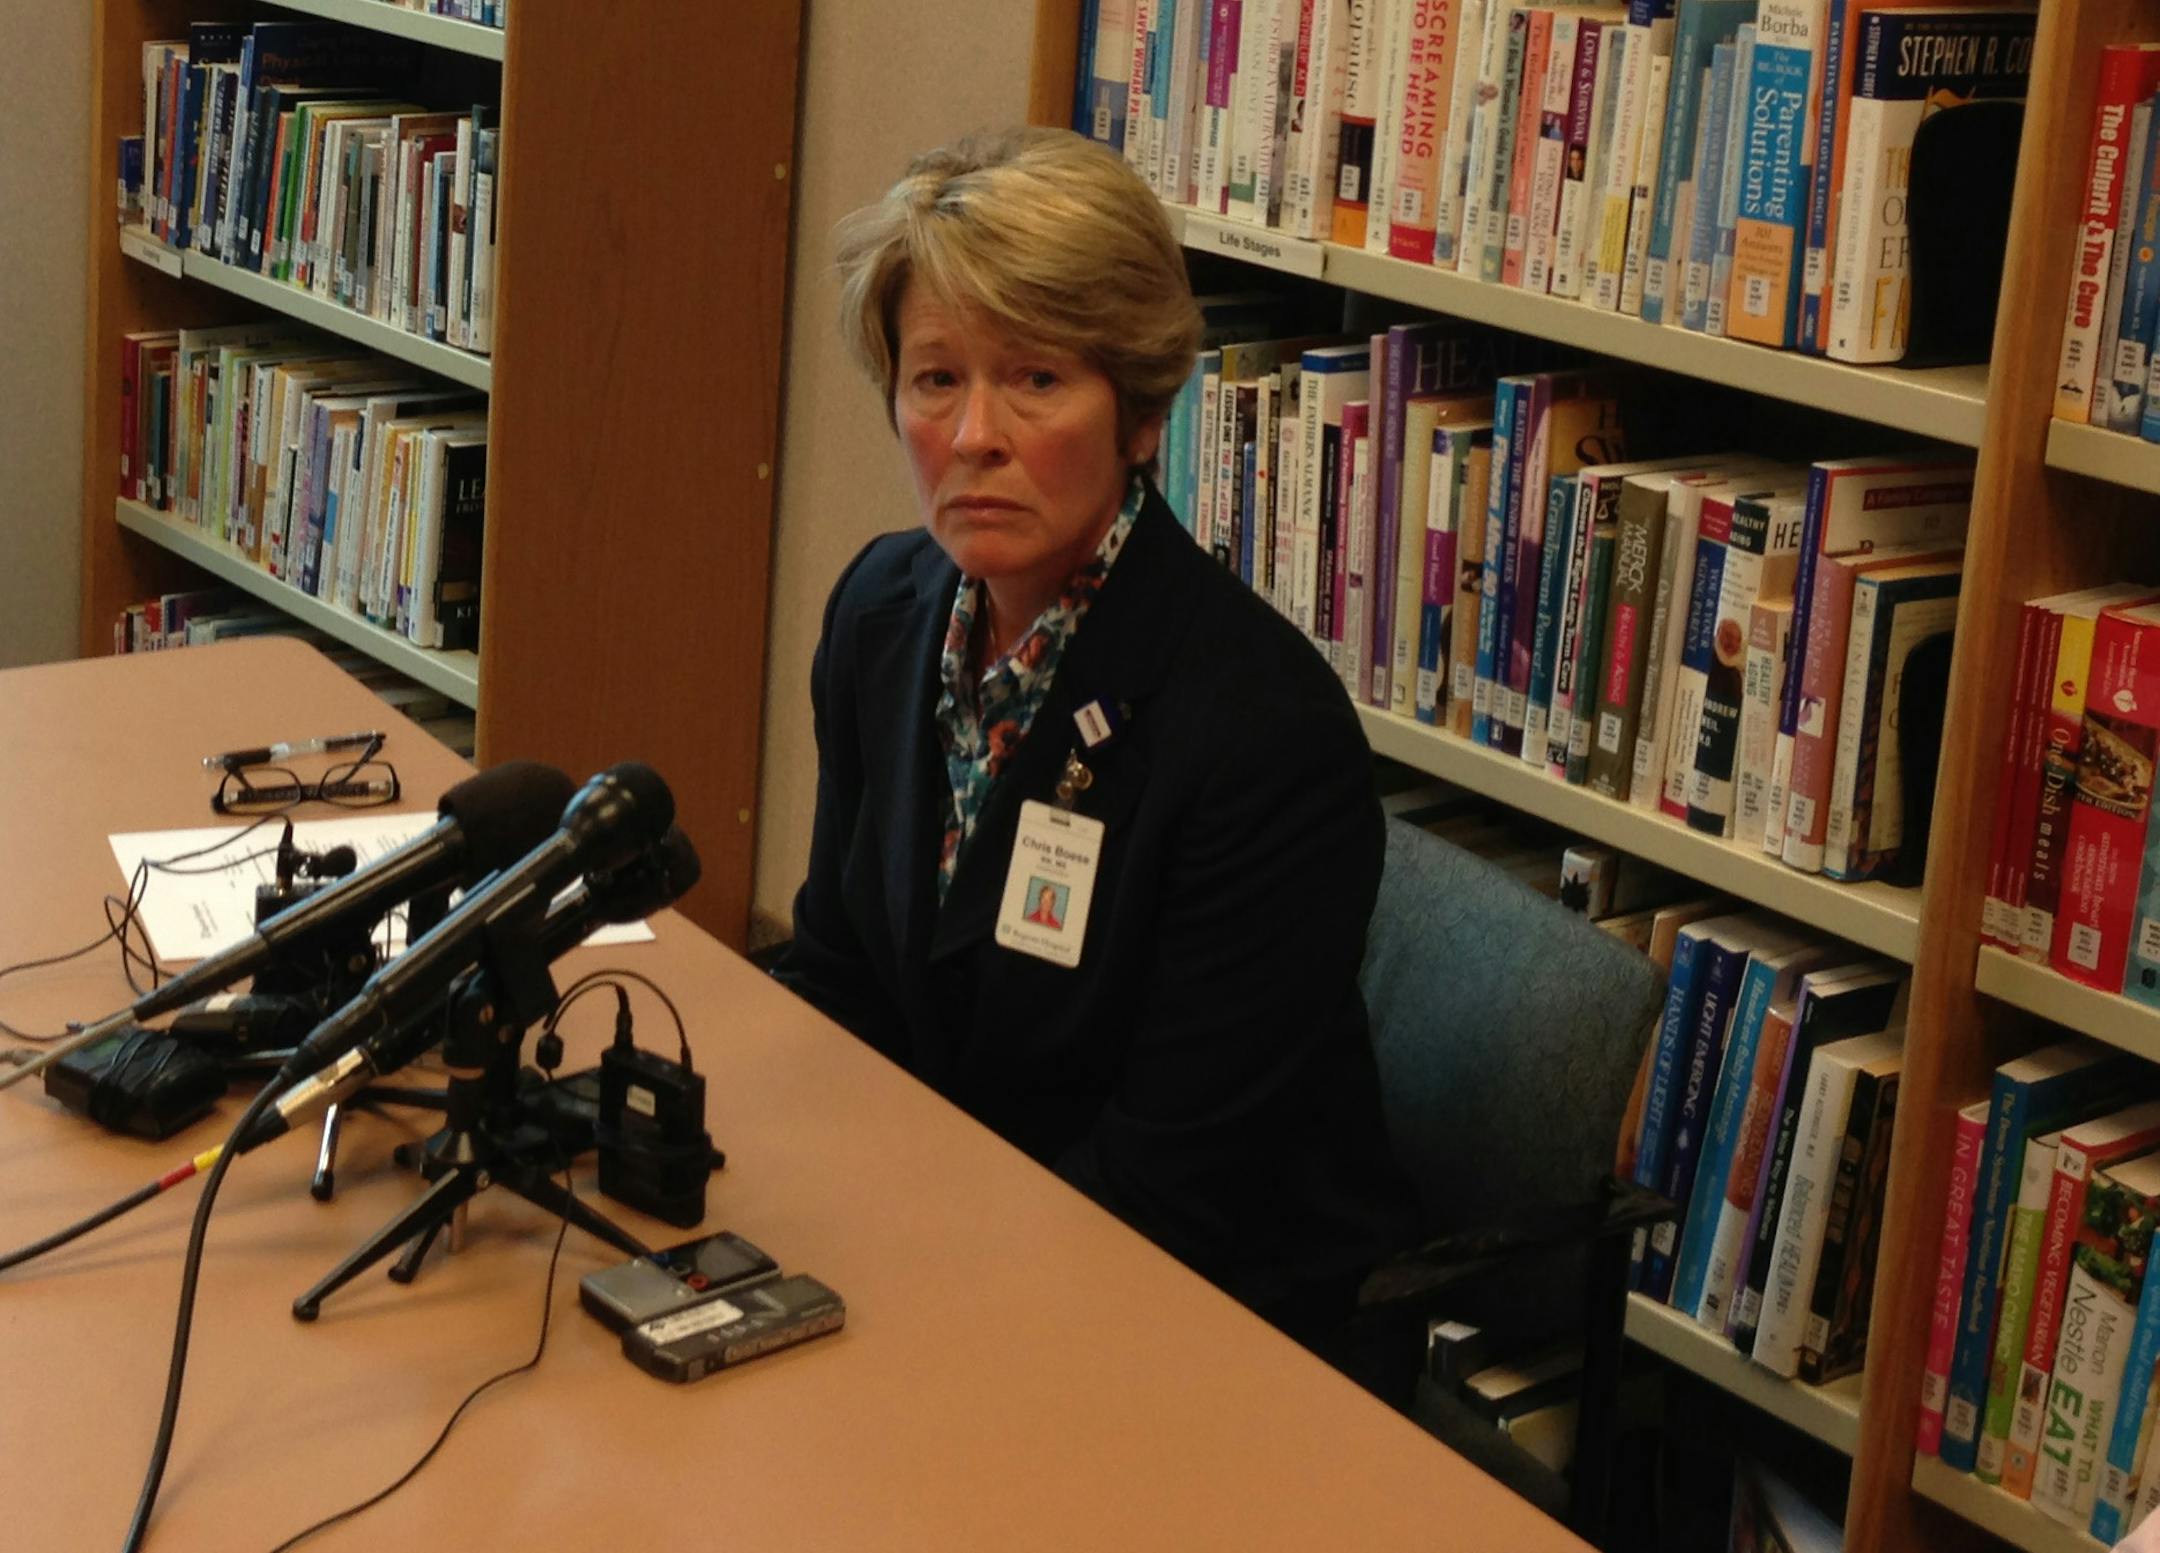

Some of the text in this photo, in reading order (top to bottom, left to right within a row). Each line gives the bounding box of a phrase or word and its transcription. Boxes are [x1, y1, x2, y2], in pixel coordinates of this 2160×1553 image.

[1131, 6, 1147, 94] SAVVY WOMAN
[1344, 2, 1363, 108] opause
[1530, 24, 1543, 47] The
[1760, 16, 1809, 37] Borba
[1825, 20, 1839, 95] PARENTING
[1866, 25, 1879, 61] STEPHEN
[1897, 36, 2034, 77] STEPHEN R. CO
[1400, 0, 1428, 154] TO BE HEARD
[1415, 0, 1448, 158] SCREAMING
[1495, 48, 1519, 170] Black Guide to
[1522, 52, 1540, 134] Relationship
[1573, 30, 1597, 141] LOVE & SURVIVAL
[1614, 32, 1641, 187] Putting Children First
[1258, 94, 1275, 175] ALTERNATIV
[1744, 86, 1778, 215] Solutions
[1822, 99, 1833, 135] WITH
[1764, 90, 1801, 223] Parenting
[1819, 138, 1829, 170] LOVE
[1814, 187, 1825, 226] LOGIC
[2074, 102, 2122, 328] The Culprit & The Cure
[1217, 231, 1283, 261] Life Stages
[1223, 424, 1231, 442] ONE
[1224, 389, 1232, 422] LESSON
[1202, 409, 1212, 484] SETTING LIMITS
[1302, 379, 1317, 521] THE FATHER'S ALMANAC
[458, 479, 482, 501] LE
[1484, 435, 1507, 565] Fitness After
[1503, 399, 1526, 583] BEATING THE SENIOR BLUES
[1578, 487, 1591, 533] Choose
[1431, 532, 1441, 561] Good
[1575, 536, 1585, 555] the
[1615, 519, 1632, 587] MANUAL
[1628, 523, 1647, 593] MERCK
[1774, 523, 1800, 549] HE
[1530, 487, 1565, 678] Grandparent Power!
[1570, 558, 1583, 589] Right
[1687, 555, 1707, 653] AGING PARENT
[1708, 567, 1719, 592] YOU
[1562, 592, 1579, 658] Long-Term
[1609, 605, 1632, 704] HEALTH AGING
[1650, 578, 1669, 660] On Women
[1700, 612, 1713, 649] YOUR
[1559, 660, 1571, 689] Care
[1745, 661, 1759, 696] AGING
[1759, 655, 1771, 706] HEALTHY
[1842, 631, 1865, 753] FINAL GIFTS
[2039, 726, 2072, 816] One-Dish
[1021, 834, 1053, 853] Chris
[2032, 821, 2056, 881] meals
[2070, 834, 2087, 893] cookbook
[2080, 843, 2096, 914] association
[2088, 831, 2110, 928] american heart
[1744, 977, 1765, 1025] Hands
[1648, 985, 1685, 1128] HANDS OF LIGHT
[1683, 990, 1718, 1119] LIGHT EMERGING
[1729, 1042, 1750, 1081] Baby
[1713, 1080, 1740, 1144] Massage
[1785, 1174, 1815, 1240] Balanced
[1932, 1132, 1971, 1329] IN GREAT TASTE
[1967, 1091, 2016, 1333] The Down Syndrome Nutrition Handbook
[1997, 1212, 2031, 1359] THE MAYO CLINIC
[2030, 1178, 2073, 1366] BECOMING VEGETARIAN
[2057, 1282, 2098, 1376] Nestle
[2086, 1311, 2118, 1375] Marion
[2041, 1378, 2084, 1466] EAT
[2076, 1398, 2104, 1482] WHAT TO
